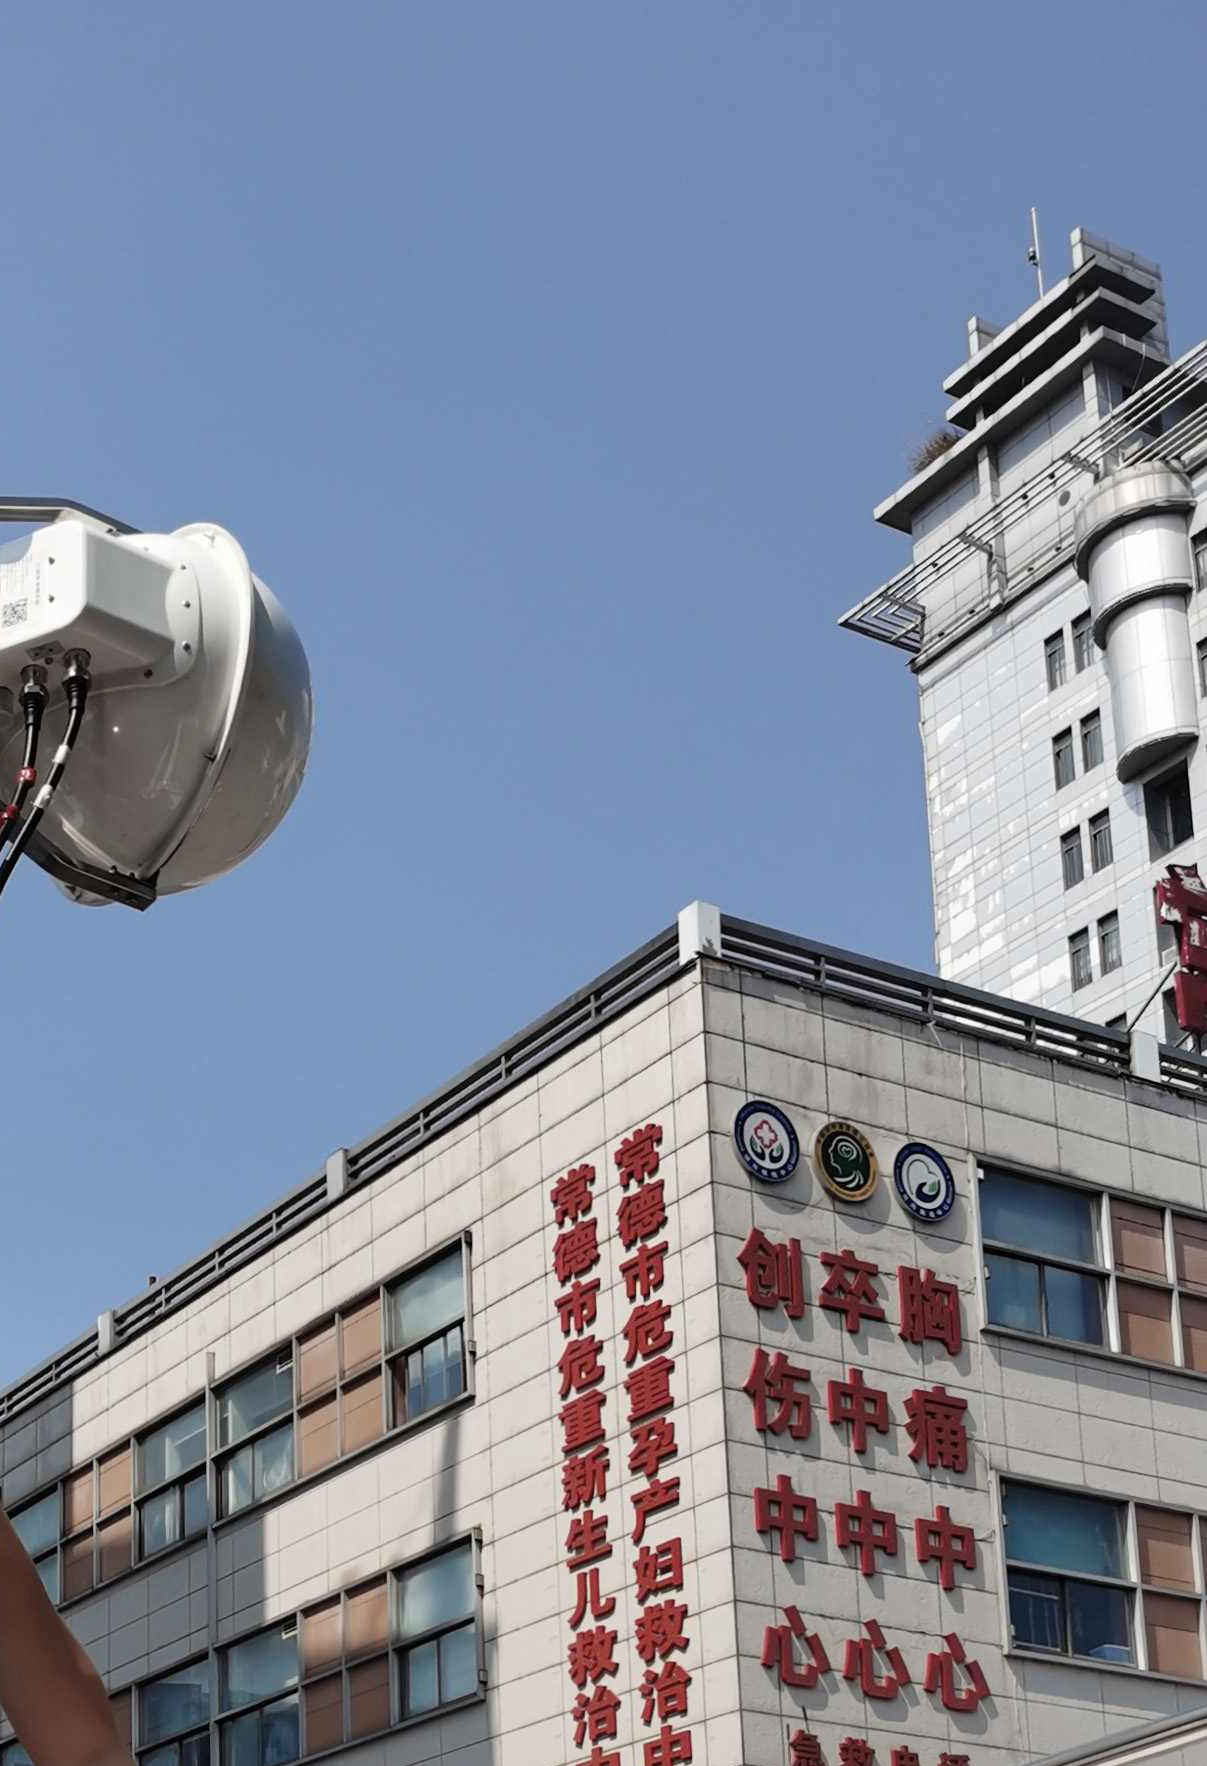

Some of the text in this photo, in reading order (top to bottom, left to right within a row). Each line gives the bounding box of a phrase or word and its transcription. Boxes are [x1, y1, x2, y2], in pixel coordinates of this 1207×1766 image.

[737, 1228, 830, 1687] 创伤中心
[819, 1250, 910, 1700] 卒中中心
[898, 1266, 990, 1712] 胸痛中心
